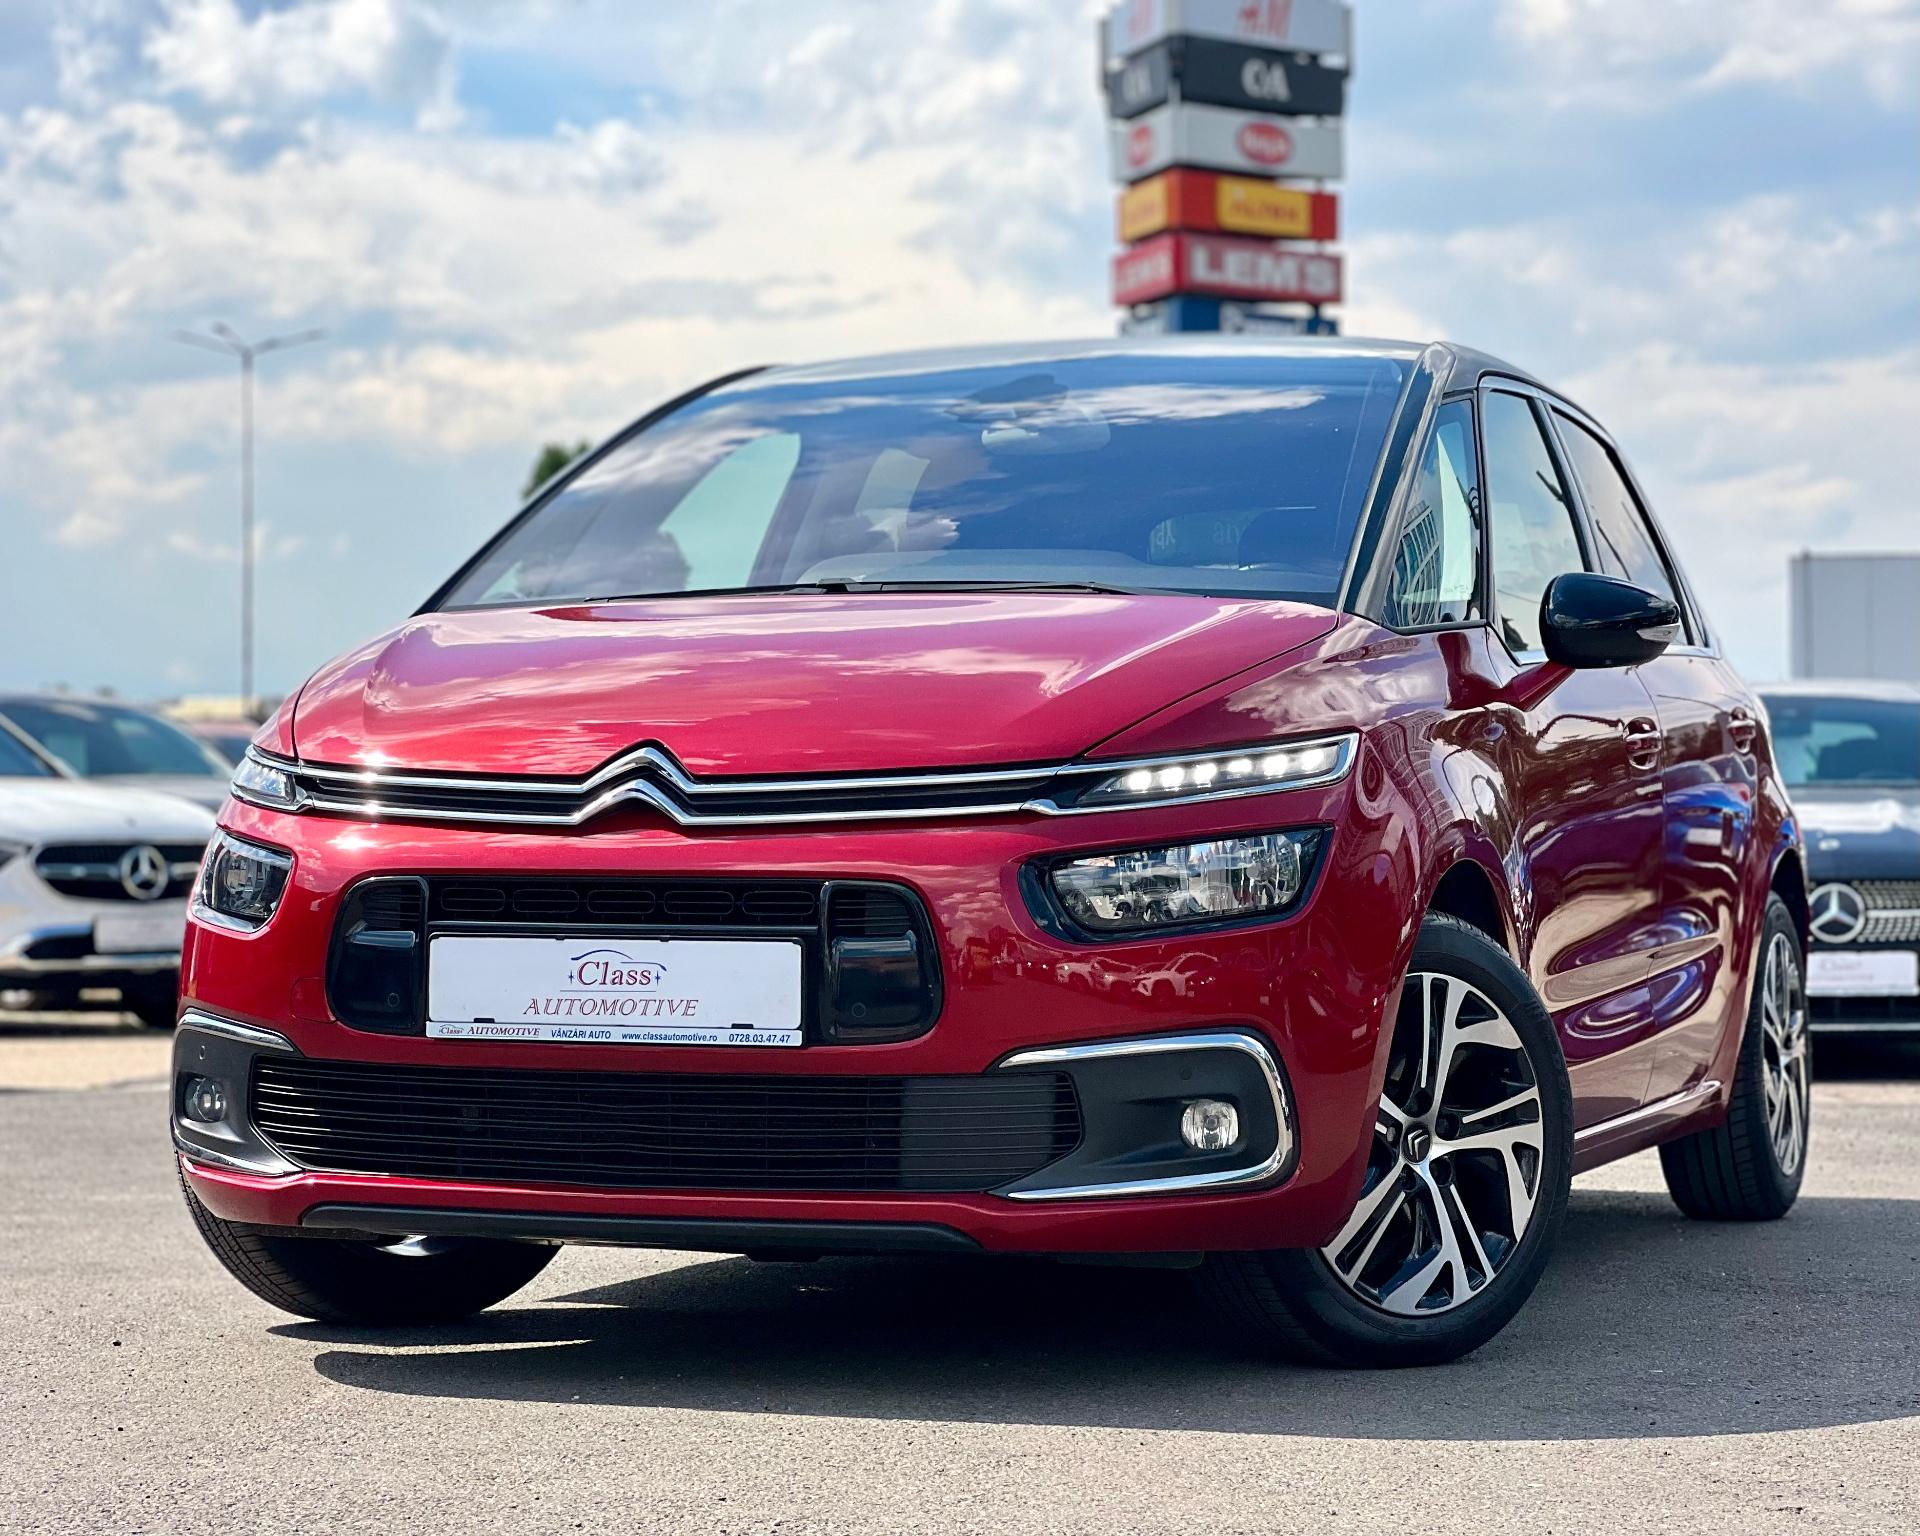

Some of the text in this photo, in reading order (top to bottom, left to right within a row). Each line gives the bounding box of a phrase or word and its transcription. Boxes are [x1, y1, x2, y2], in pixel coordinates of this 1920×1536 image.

[577, 961, 652, 986] Class
[522, 998, 699, 1017] AUTOMOTIVE
[439, 1025, 461, 1035] Class
[467, 1026, 540, 1036] AUTOMOTIVE
[588, 1030, 612, 1040] AUTO
[621, 1031, 718, 1042] www.classautomotive.ro
[729, 1033, 791, 1043] 0728.03.47.47
